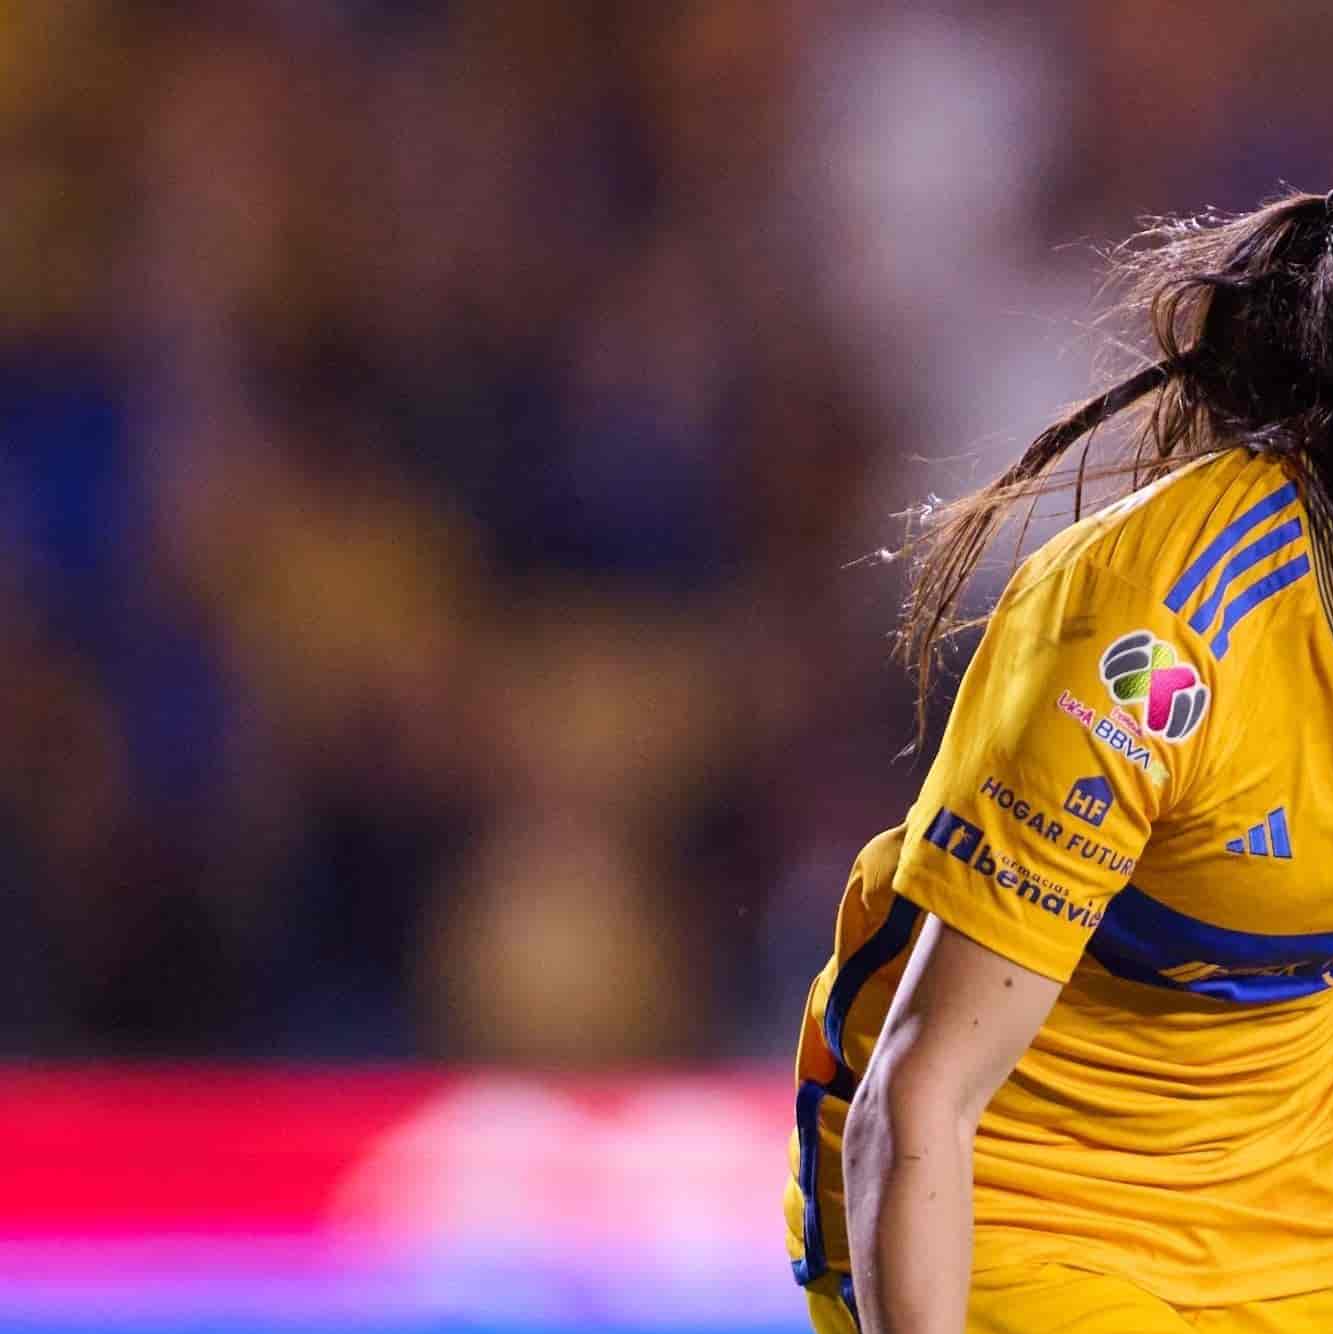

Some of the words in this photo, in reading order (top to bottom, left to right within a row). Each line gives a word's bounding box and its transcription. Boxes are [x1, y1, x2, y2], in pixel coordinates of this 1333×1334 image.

[1095, 719, 1150, 769] BBVA
[980, 776, 1063, 843] HOGAR
[1067, 789, 1107, 820] HF
